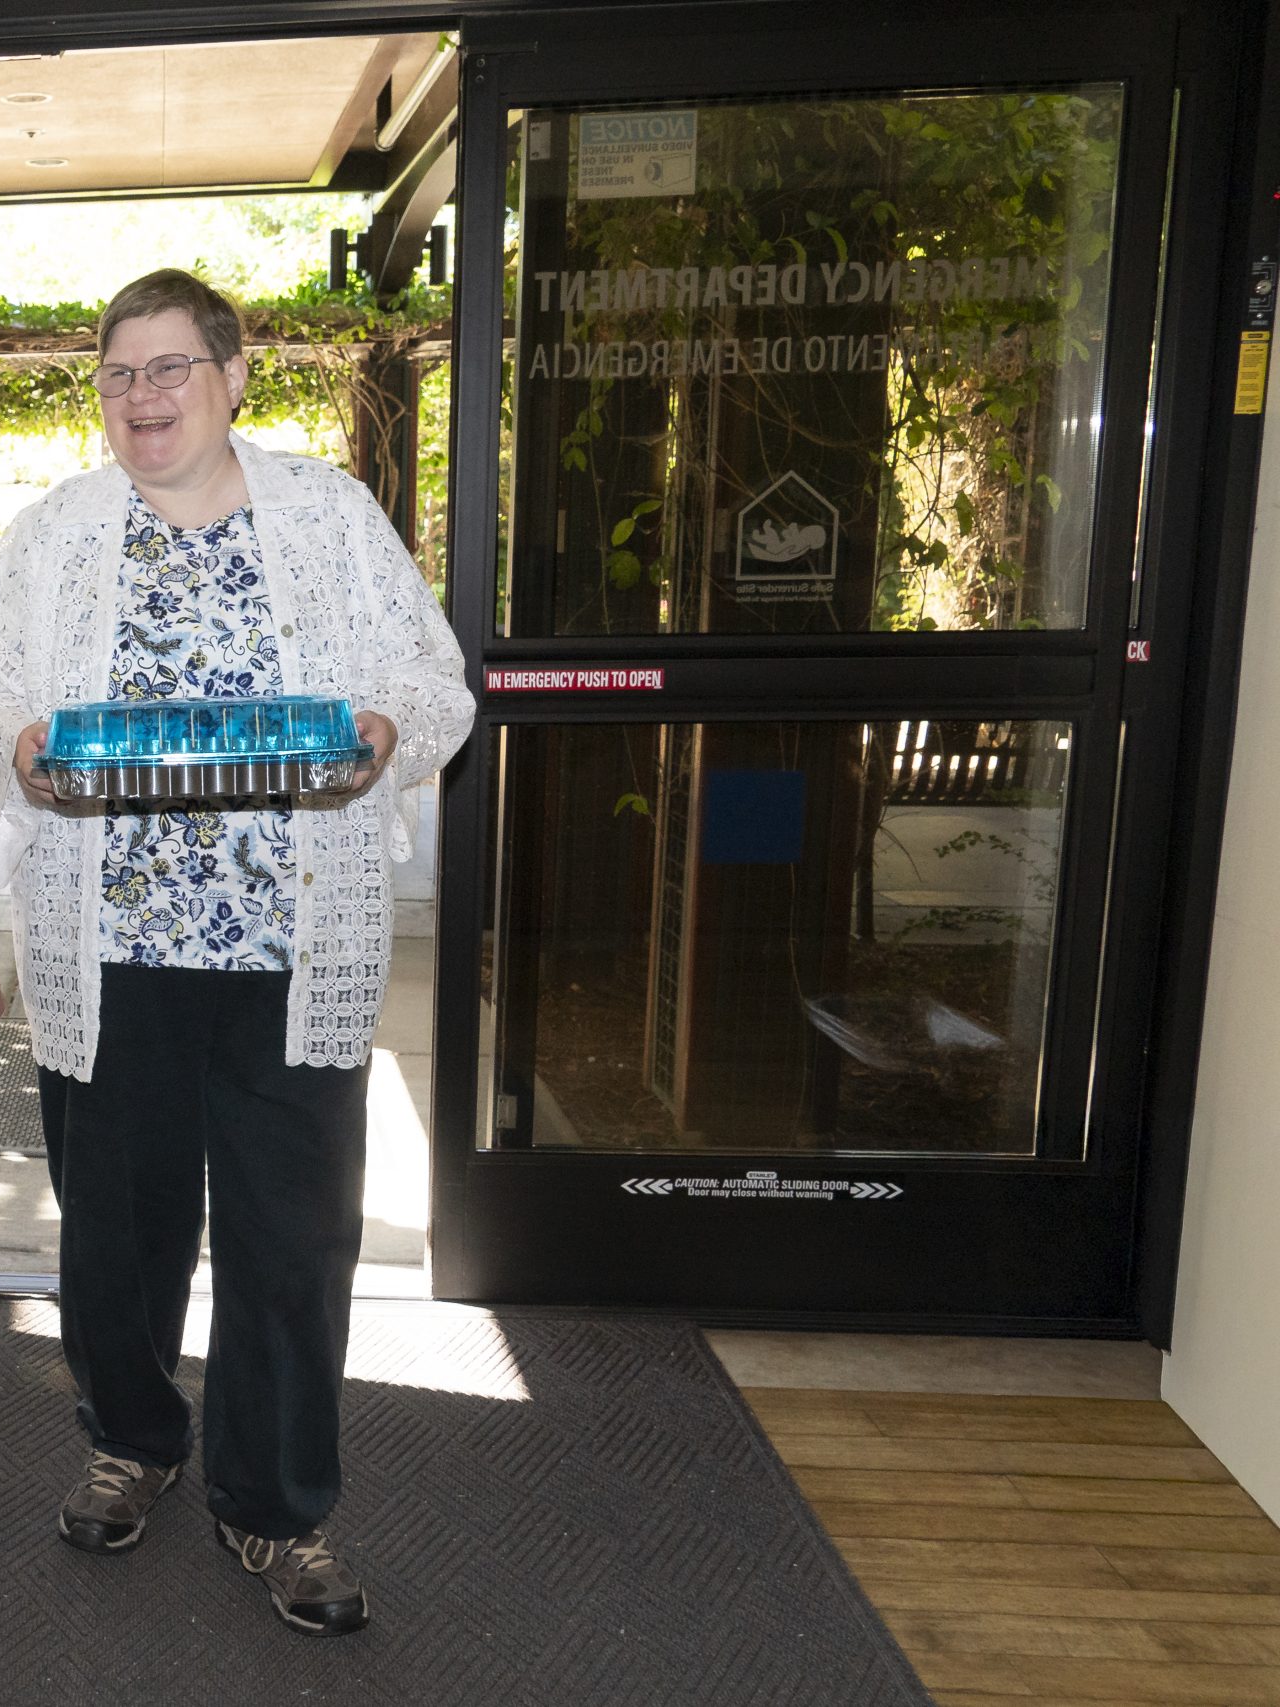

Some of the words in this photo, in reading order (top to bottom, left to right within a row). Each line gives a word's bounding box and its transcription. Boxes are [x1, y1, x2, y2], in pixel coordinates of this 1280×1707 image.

[489, 672, 502, 689] IN
[504, 672, 575, 688] EMERGENCY
[577, 671, 609, 688] PUSH
[611, 671, 627, 687] TO
[629, 671, 662, 687] OPEN
[675, 1178, 720, 1189] CAUTION:
[722, 1179, 781, 1189] AUTOMATIC
[781, 1180, 820, 1190] SLIDING
[822, 1181, 849, 1191] DOOR
[688, 1187, 710, 1197] Door
[711, 1189, 730, 1199] may
[732, 1188, 757, 1198] close
[758, 1189, 794, 1198] without
[795, 1190, 833, 1201] warning
